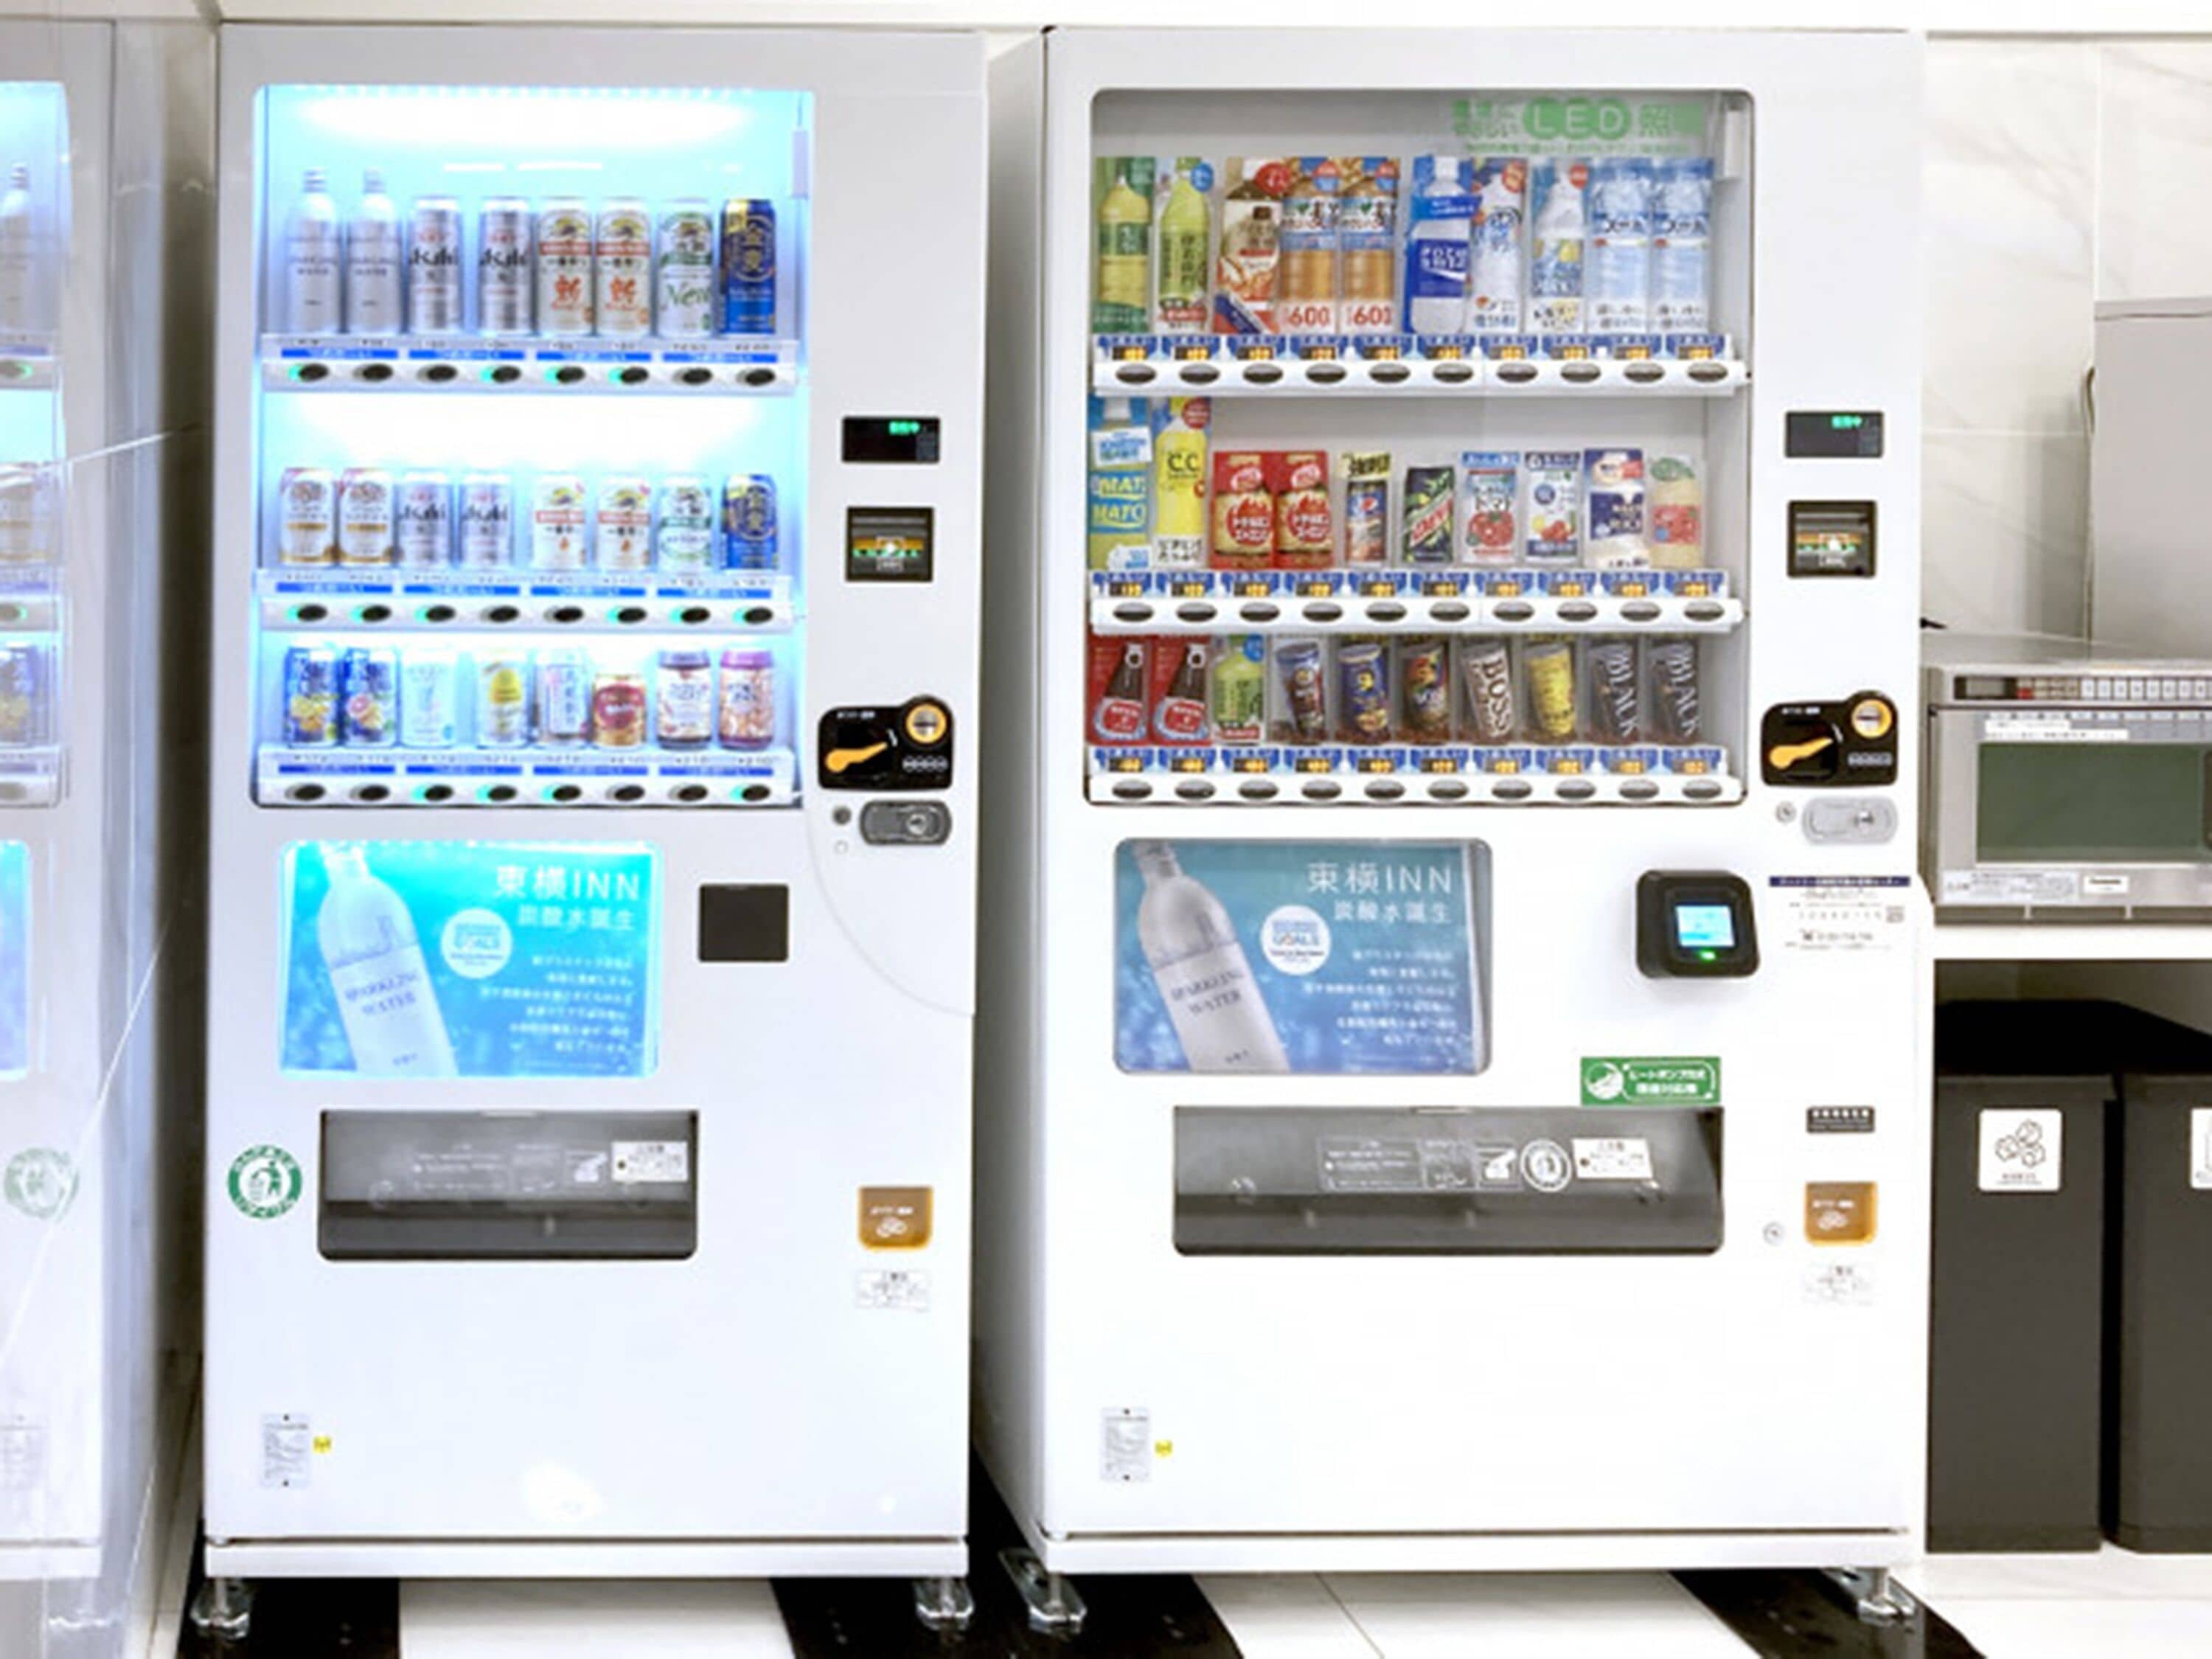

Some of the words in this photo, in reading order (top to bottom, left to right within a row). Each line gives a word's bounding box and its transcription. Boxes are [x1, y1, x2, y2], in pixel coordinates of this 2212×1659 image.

[1532, 105, 1625, 131] LED
[495, 864, 640, 902] 東横INN
[1307, 860, 1453, 894] 東横INN
[1189, 990, 1242, 1015] WATER
